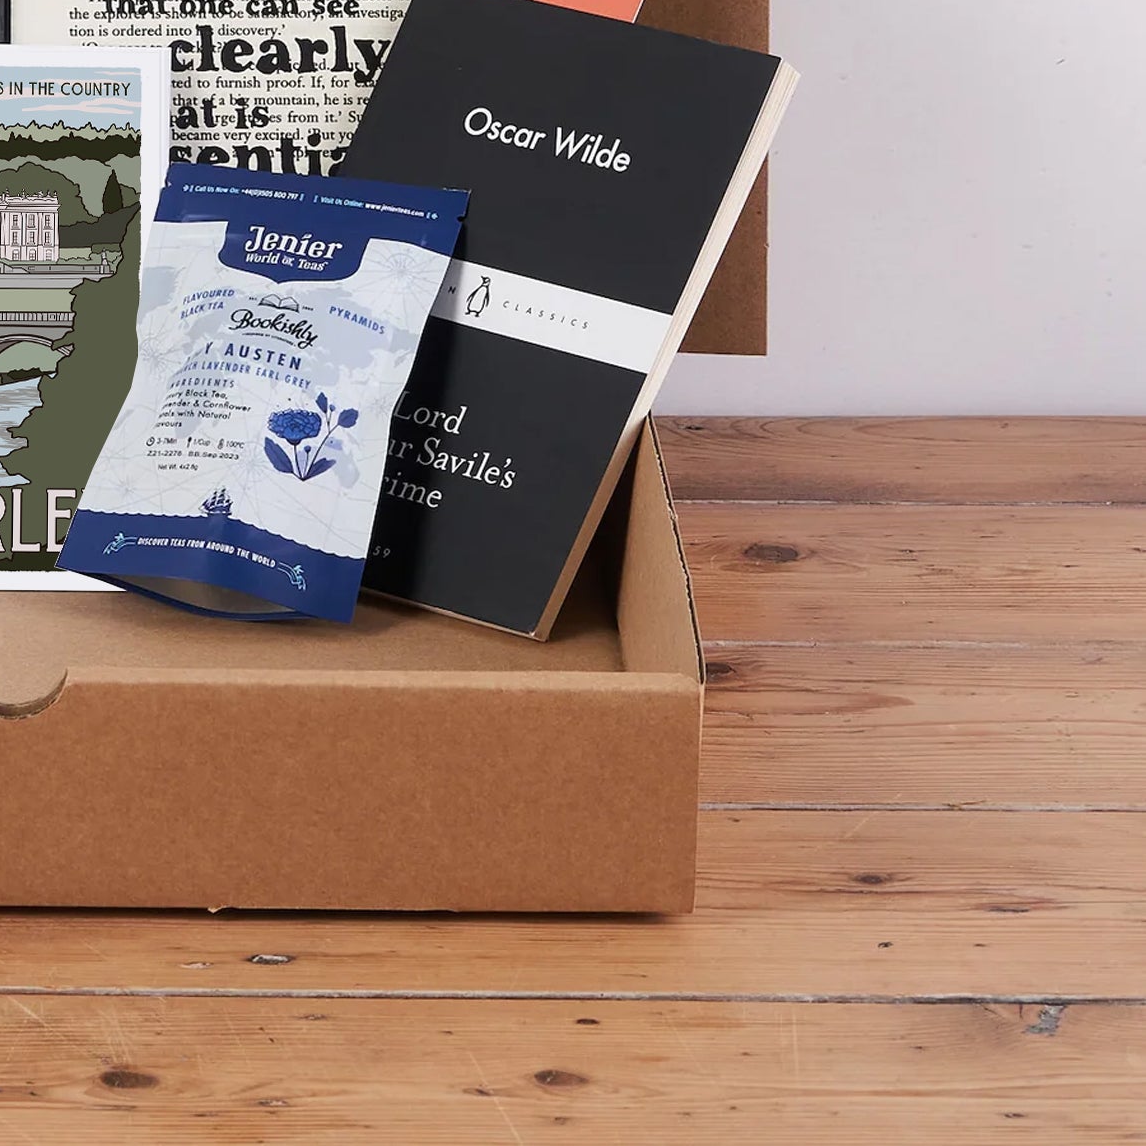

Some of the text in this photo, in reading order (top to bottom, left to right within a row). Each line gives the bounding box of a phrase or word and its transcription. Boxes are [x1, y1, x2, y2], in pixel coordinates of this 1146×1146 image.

[69, 7, 89, 19] the
[180, 0, 234, 15] one
[246, 0, 299, 15] can
[312, 0, 360, 15] see
[69, 25, 94, 37] tion
[98, 25, 108, 37] is
[112, 24, 162, 37] ordered
[166, 24, 192, 36] into
[170, 25, 391, 82] clearly
[9, 81, 23, 95] IN
[29, 82, 55, 96] THE
[60, 82, 131, 97] COUNTRY
[197, 78, 210, 88] to
[216, 76, 260, 88] furnish
[267, 76, 305, 91] proof.
[311, 76, 325, 89] If,
[331, 76, 350, 88] for
[173, 94, 198, 106] that
[218, 98, 225, 106] a
[254, 94, 320, 107] mountain,
[324, 94, 339, 105] he
[343, 94, 353, 105] is
[235, 98, 270, 129] is
[287, 111, 319, 123] from
[171, 129, 220, 141] became
[223, 133, 251, 144] very
[463, 107, 631, 172] Oscar Wilde
[245, 252, 280, 264] World
[298, 258, 329, 271] Teas
[182, 289, 235, 305] FLAVOURED
[180, 301, 224, 320] BLACK TEA
[502, 300, 590, 330] CLASSICS
[228, 308, 318, 350] Bookishly
[329, 306, 386, 335] PYRAMIDS
[224, 343, 302, 370] AUSTEN
[201, 361, 251, 374] LAVENDER
[256, 367, 280, 381] EARL
[285, 375, 311, 390] GREY
[185, 389, 207, 397] Black
[198, 411, 232, 420] Natural
[204, 400, 252, 412] Cornflower
[393, 391, 468, 434] Lord
[383, 472, 443, 509] rime
[137, 537, 276, 568] DISCOVER TEAS FROM AROUND THE WORLD
